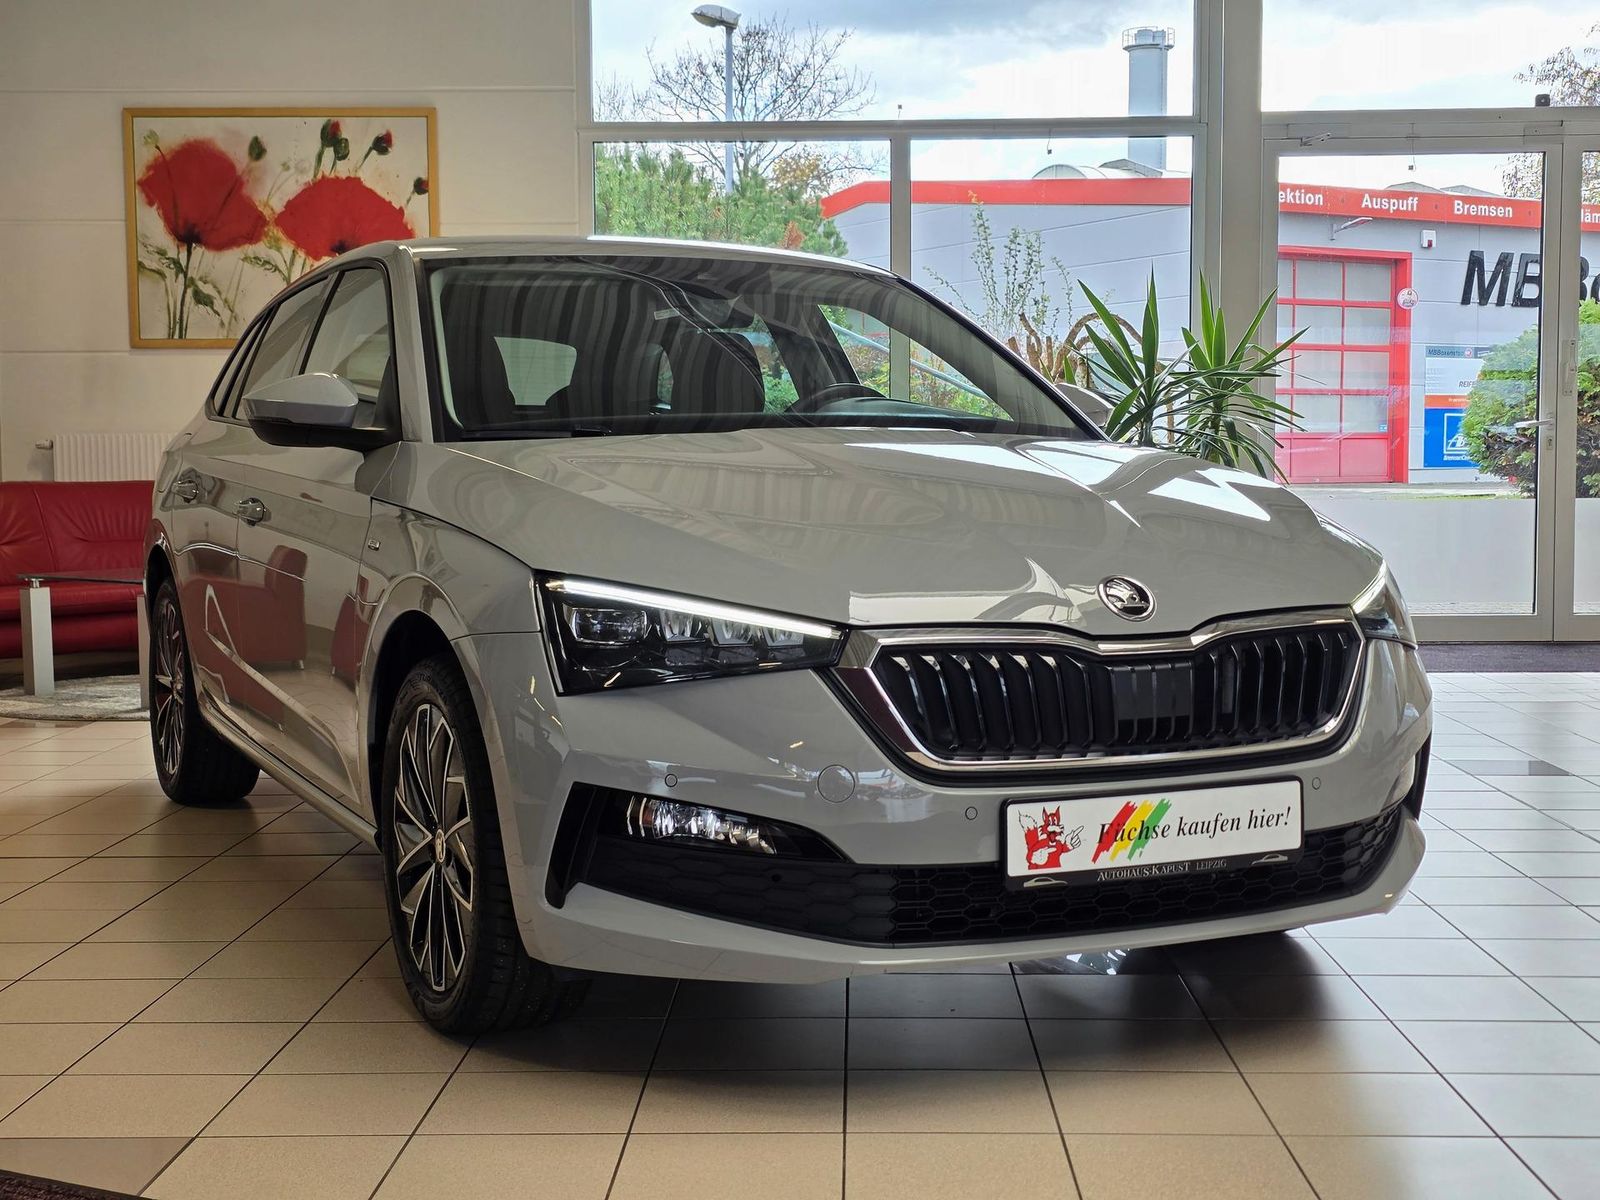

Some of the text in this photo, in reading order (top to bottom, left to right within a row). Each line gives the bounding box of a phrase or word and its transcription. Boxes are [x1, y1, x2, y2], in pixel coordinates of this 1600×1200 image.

[1361, 194, 1419, 213] Auspuff
[1454, 200, 1513, 218] Bremsen
[1097, 806, 1291, 844] Füchse kaufen hier!
[1196, 859, 1227, 871] LEIPZIG
